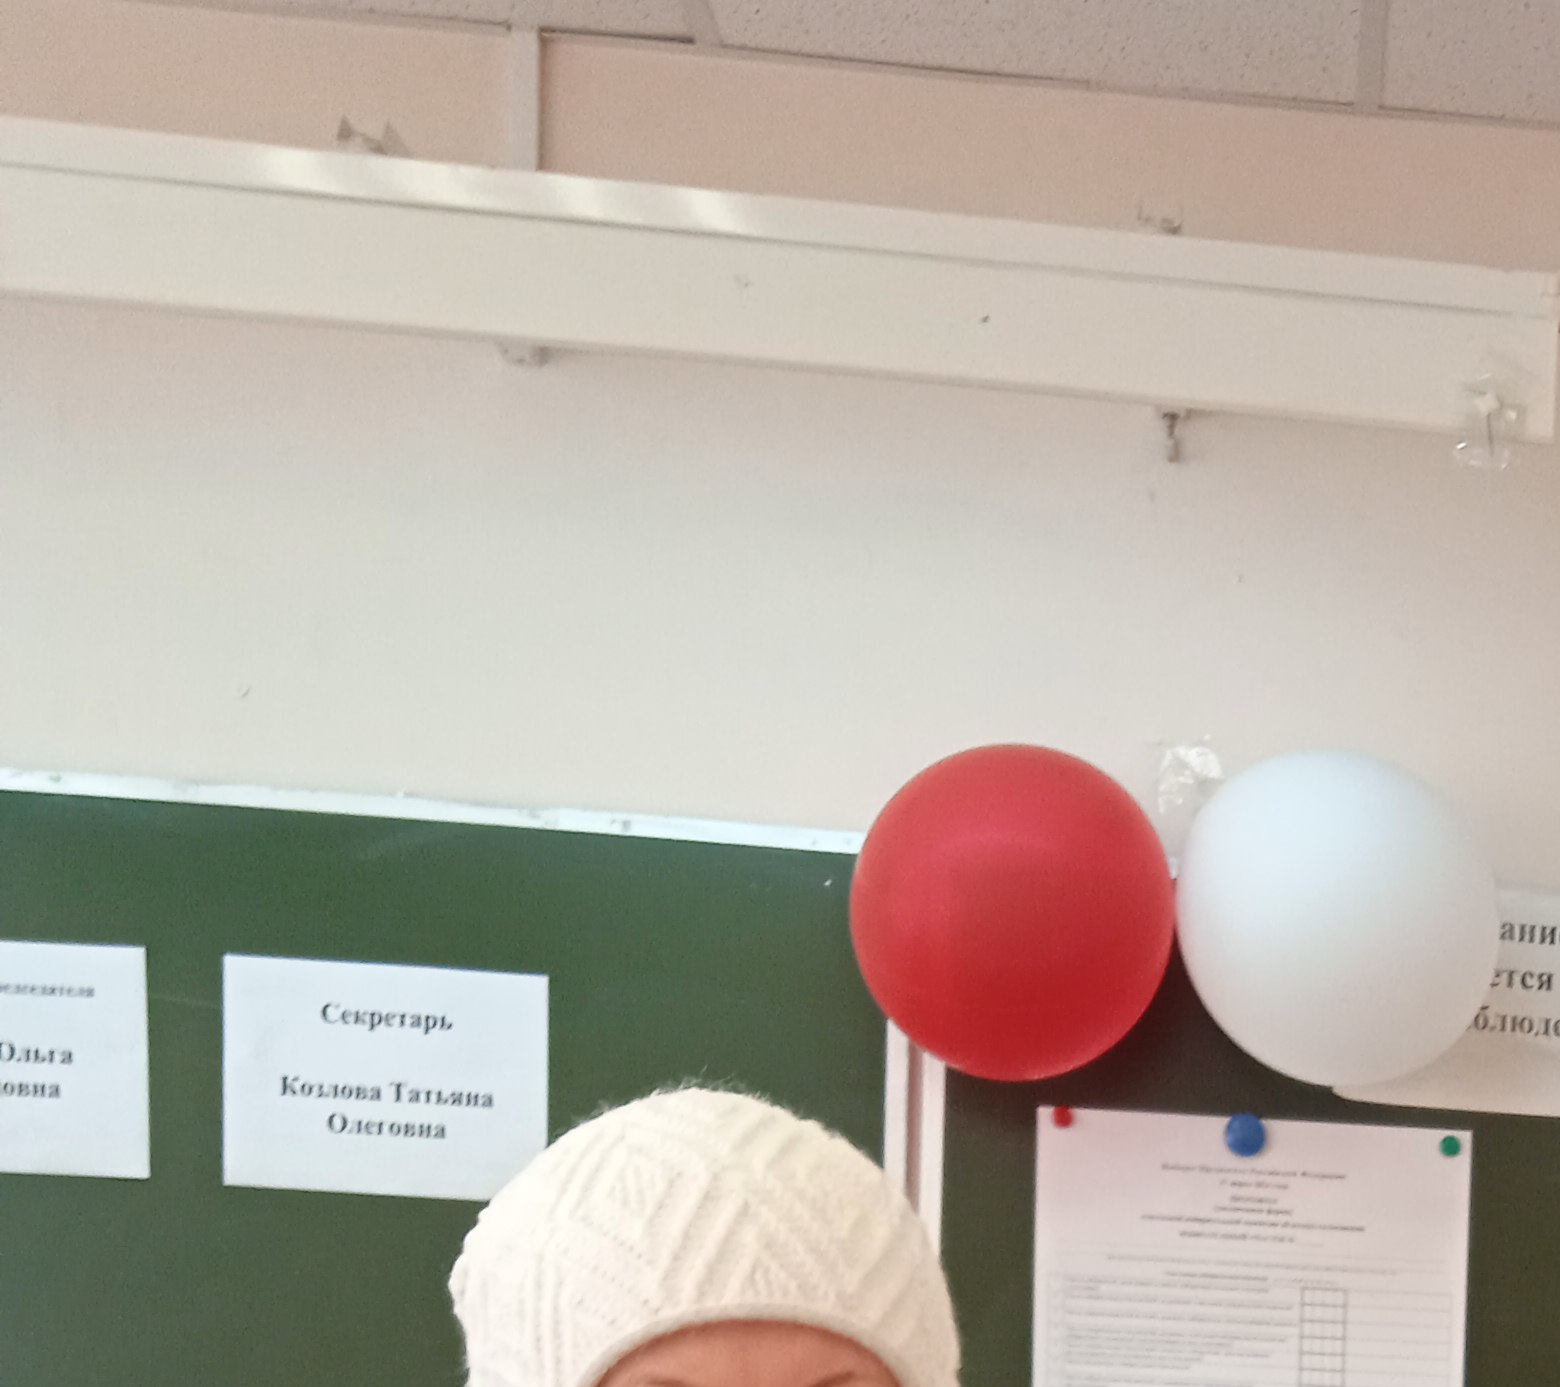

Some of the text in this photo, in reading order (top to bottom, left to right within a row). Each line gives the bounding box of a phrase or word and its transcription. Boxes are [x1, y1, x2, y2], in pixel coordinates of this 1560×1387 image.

[321, 1002, 453, 1036] Секретарь
[0, 1042, 74, 1065] Ольга
[280, 1074, 496, 1109] Козлова Татьяна
[327, 1112, 447, 1140] Олеговна
